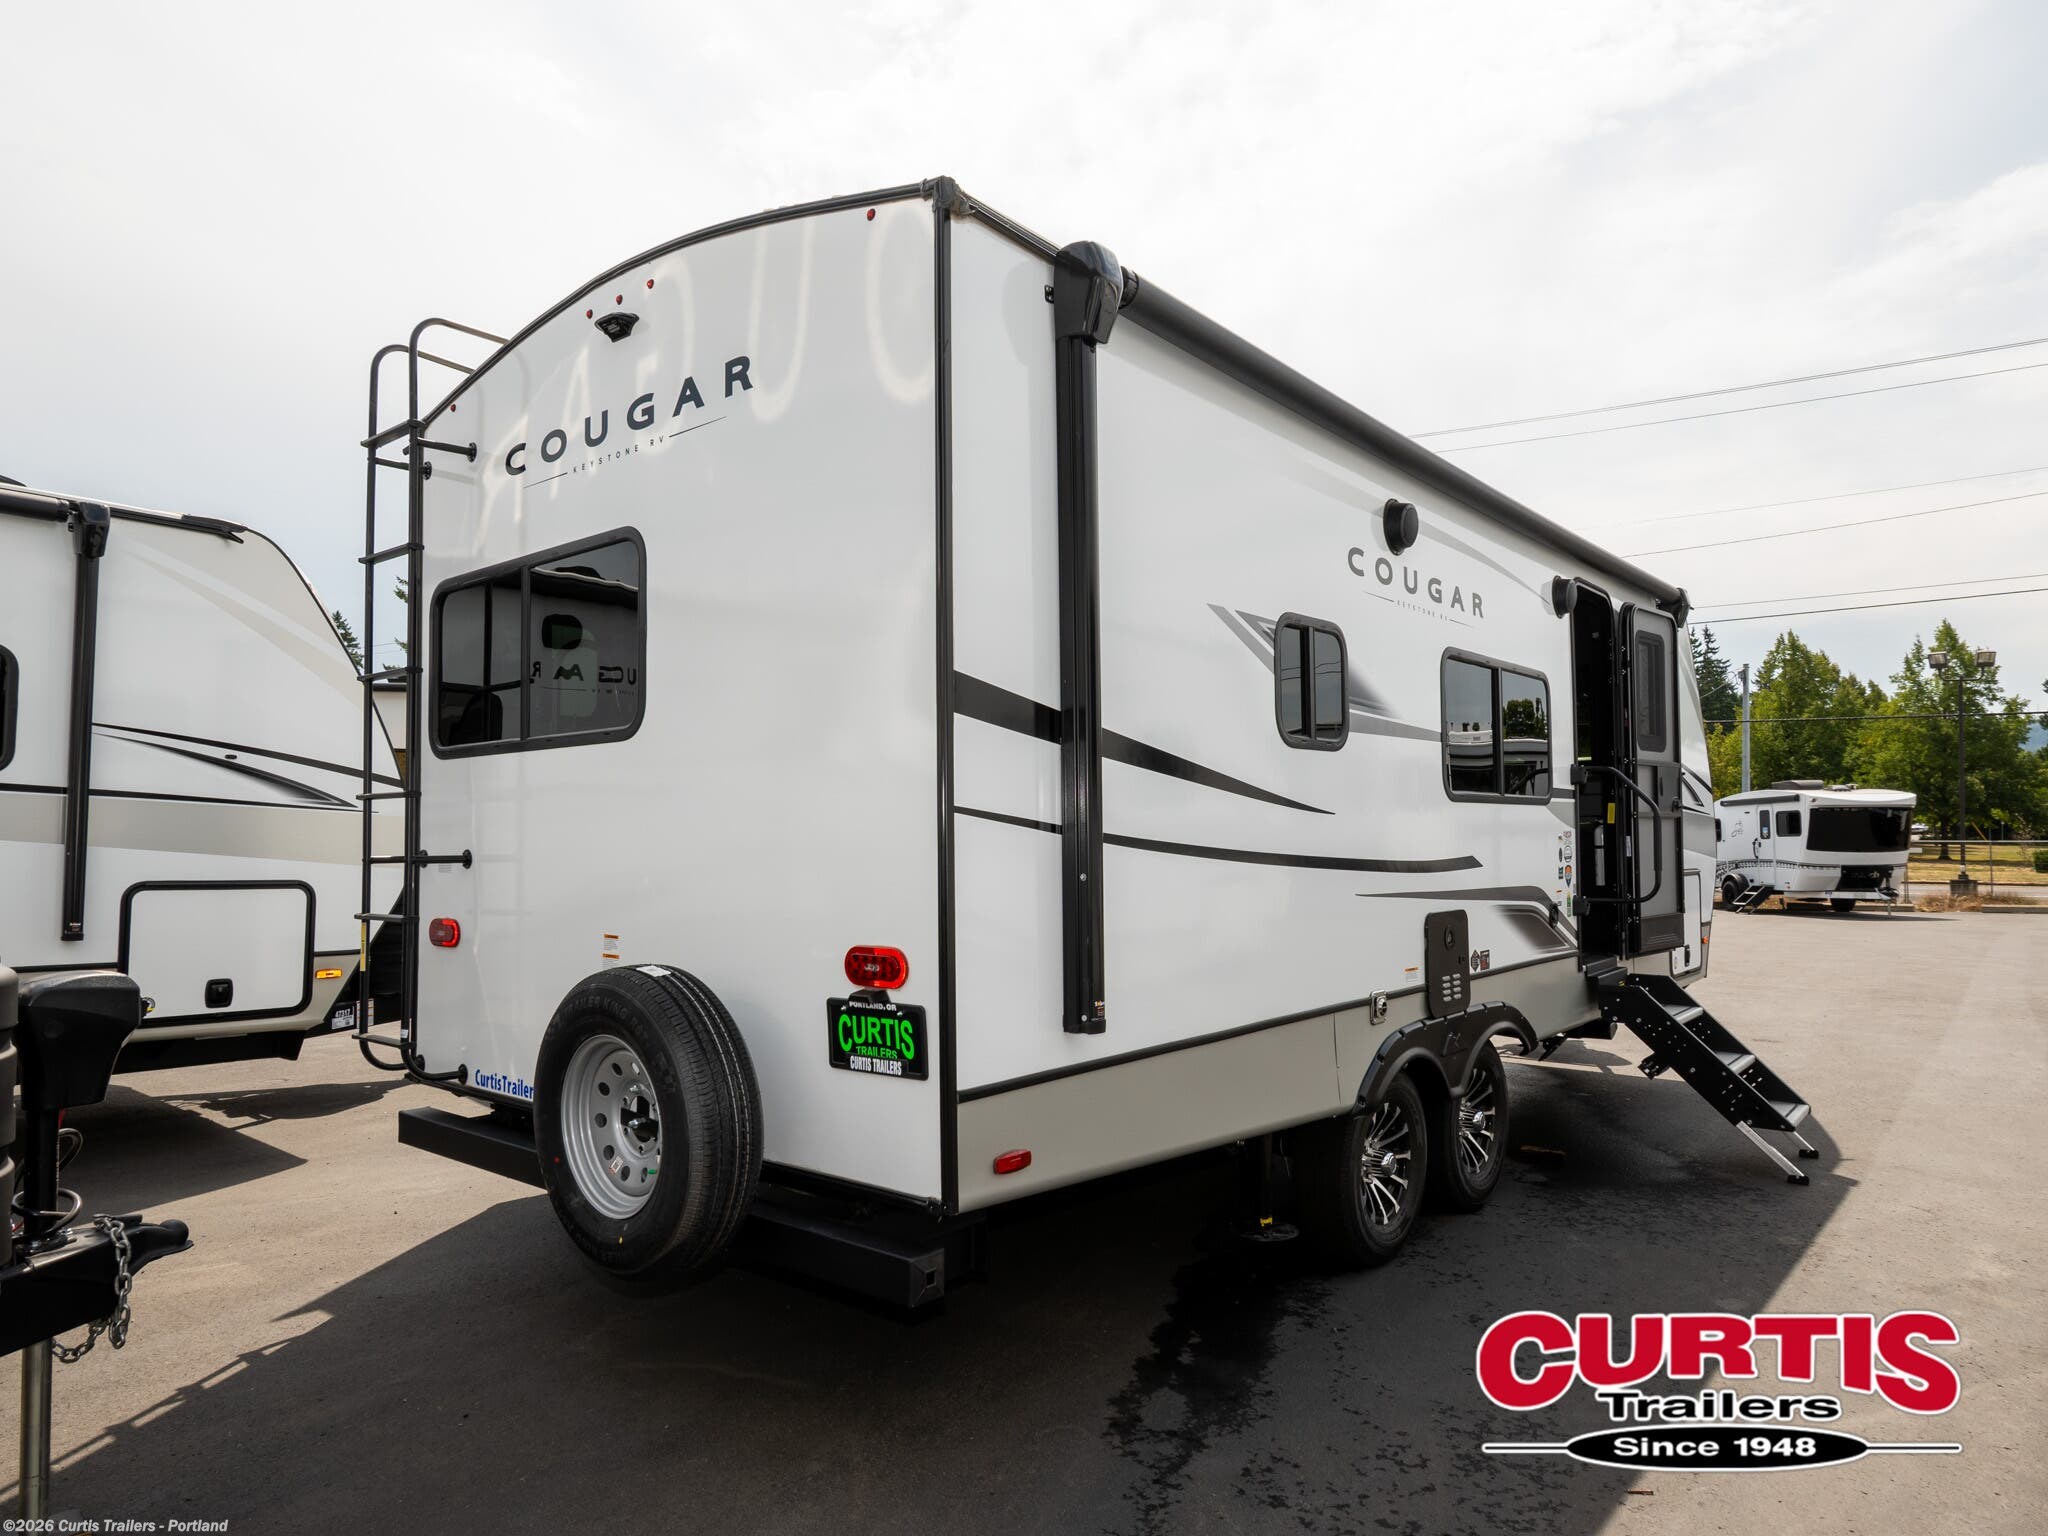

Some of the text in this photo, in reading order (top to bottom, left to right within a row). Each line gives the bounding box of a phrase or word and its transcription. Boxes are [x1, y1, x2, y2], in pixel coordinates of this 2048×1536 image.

[504, 356, 754, 476] COUGAR
[573, 435, 664, 473] KEYSTONE RV
[1347, 548, 1485, 619] COUGAR
[838, 1014, 915, 1059] CURTIS
[856, 1046, 898, 1059] TRAILERS
[850, 1055, 902, 1075] CURTIS TRAILERS
